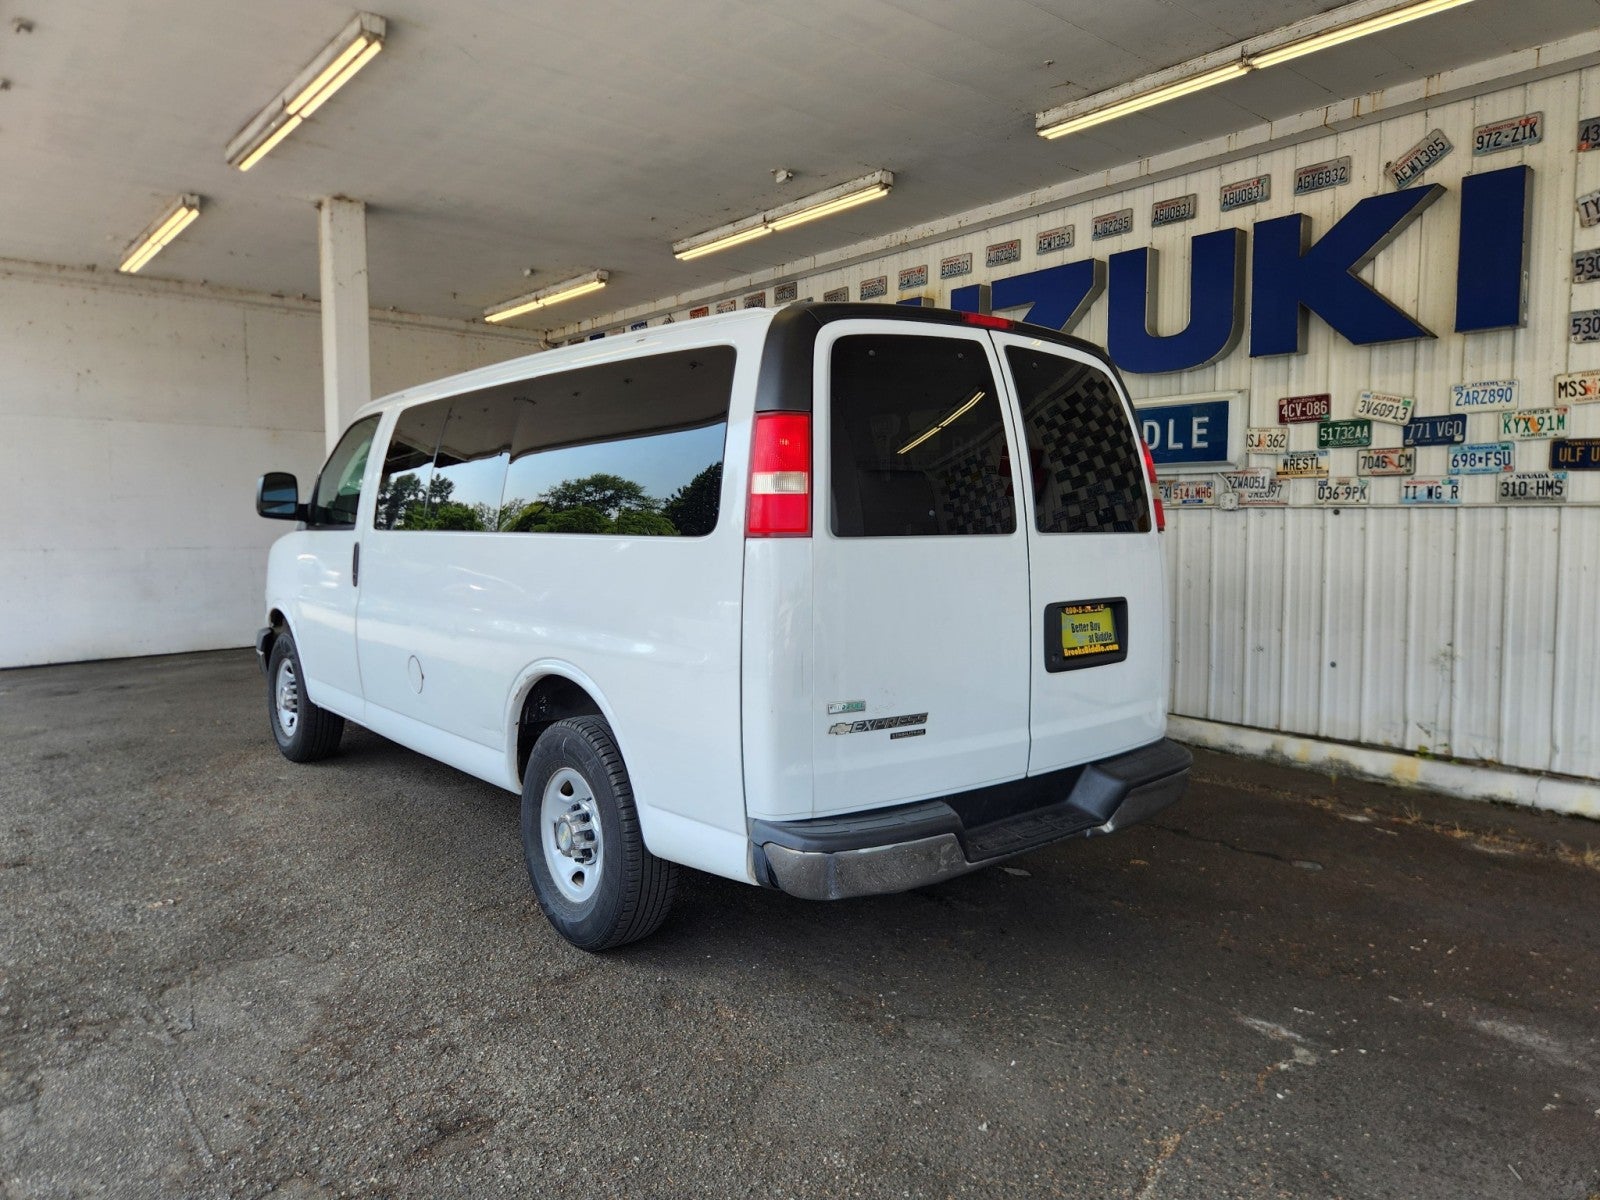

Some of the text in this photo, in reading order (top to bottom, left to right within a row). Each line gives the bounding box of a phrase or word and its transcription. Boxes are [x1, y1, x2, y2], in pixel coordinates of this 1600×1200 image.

[1394, 137, 1446, 184] AEW1385
[1296, 166, 1346, 191] AGY6832
[1222, 184, 1265, 207] ABU0831
[1153, 202, 1192, 222] ABU0831
[896, 164, 1532, 375] ZUKI
[1455, 387, 1513, 406] 2ARZ890
[1558, 380, 1588, 399] MSS
[1281, 400, 1328, 418] 4CV-086
[1142, 416, 1209, 450] DLE
[1320, 425, 1369, 441] 51732AA
[1407, 422, 1431, 440] 771
[1503, 416, 1531, 434] KYX
[1266, 433, 1286, 448] 362
[1283, 457, 1322, 471] WRESTL
[1361, 455, 1388, 469] 7046
[1451, 451, 1511, 468] 698 FSU
[1071, 622, 1089, 634] Better
[850, 712, 928, 733] EXPRESS
